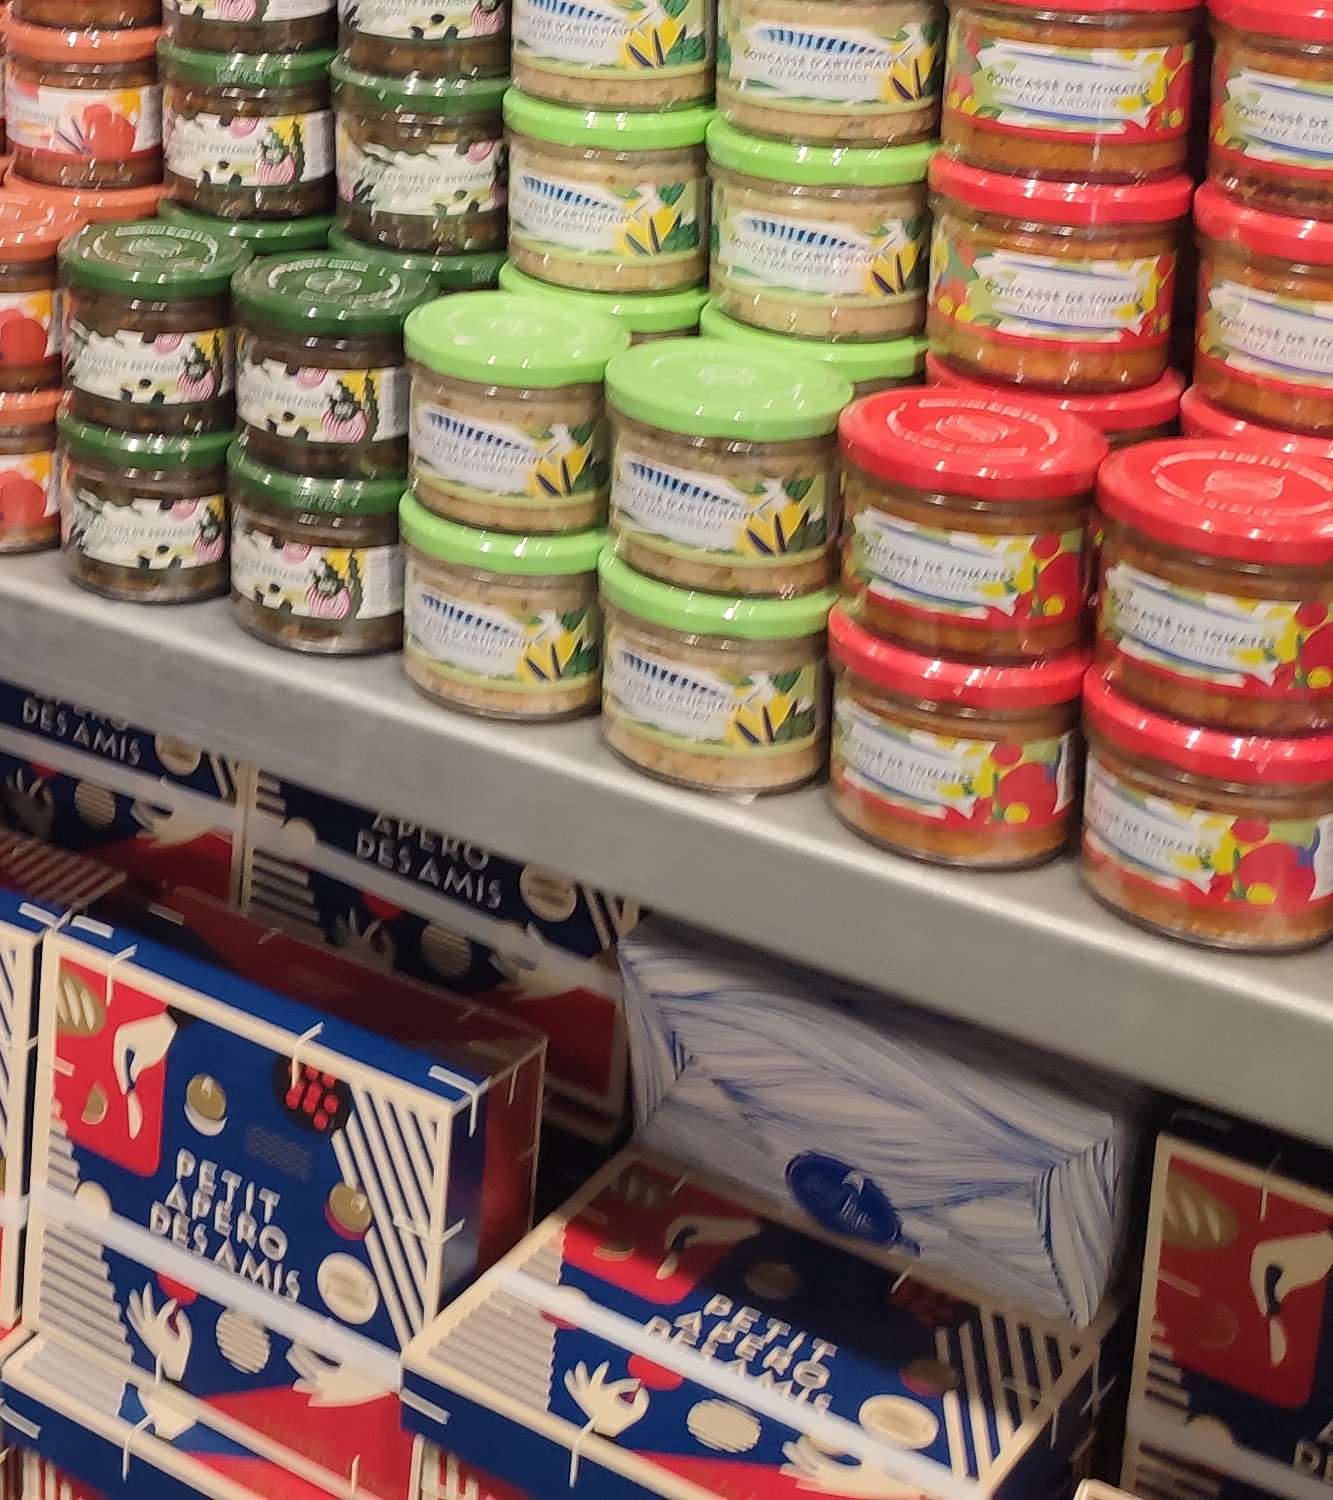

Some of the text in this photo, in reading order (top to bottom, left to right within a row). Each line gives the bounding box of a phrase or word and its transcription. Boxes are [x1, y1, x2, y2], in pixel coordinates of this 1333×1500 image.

[743, 48, 898, 73] CONCASSÉ D'ARTICHAUT
[985, 72, 1152, 96] CONCASSÉ DE TOMATES
[22, 698, 142, 767] DES AMIS
[355, 836, 502, 910] DES AMIS
[176, 1147, 281, 1224] PETIT
[149, 1200, 301, 1302] DES AMIS
[703, 1293, 839, 1362] PETIT
